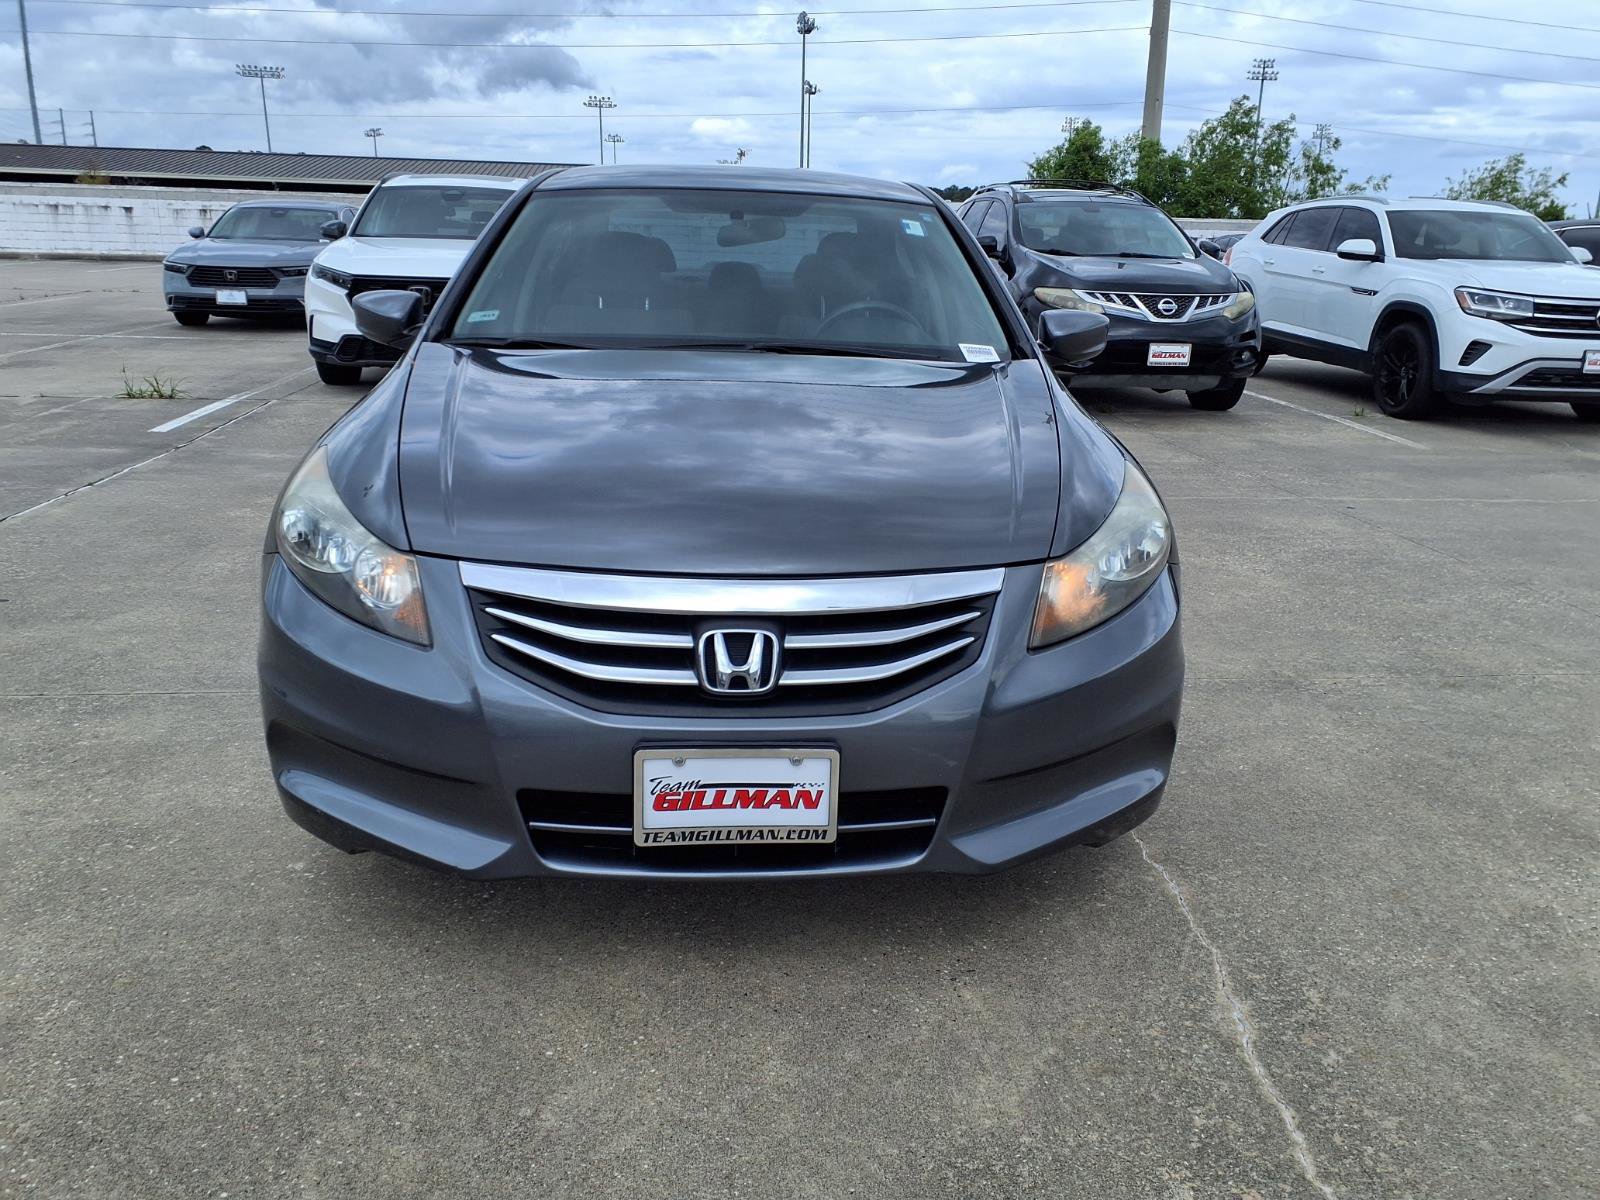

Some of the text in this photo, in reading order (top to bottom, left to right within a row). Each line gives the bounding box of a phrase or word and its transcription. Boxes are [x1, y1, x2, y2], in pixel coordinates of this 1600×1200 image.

[649, 775, 702, 796] Team
[652, 789, 824, 812] GILLMAN
[642, 829, 828, 844] TEAMGILLMAN.COM
